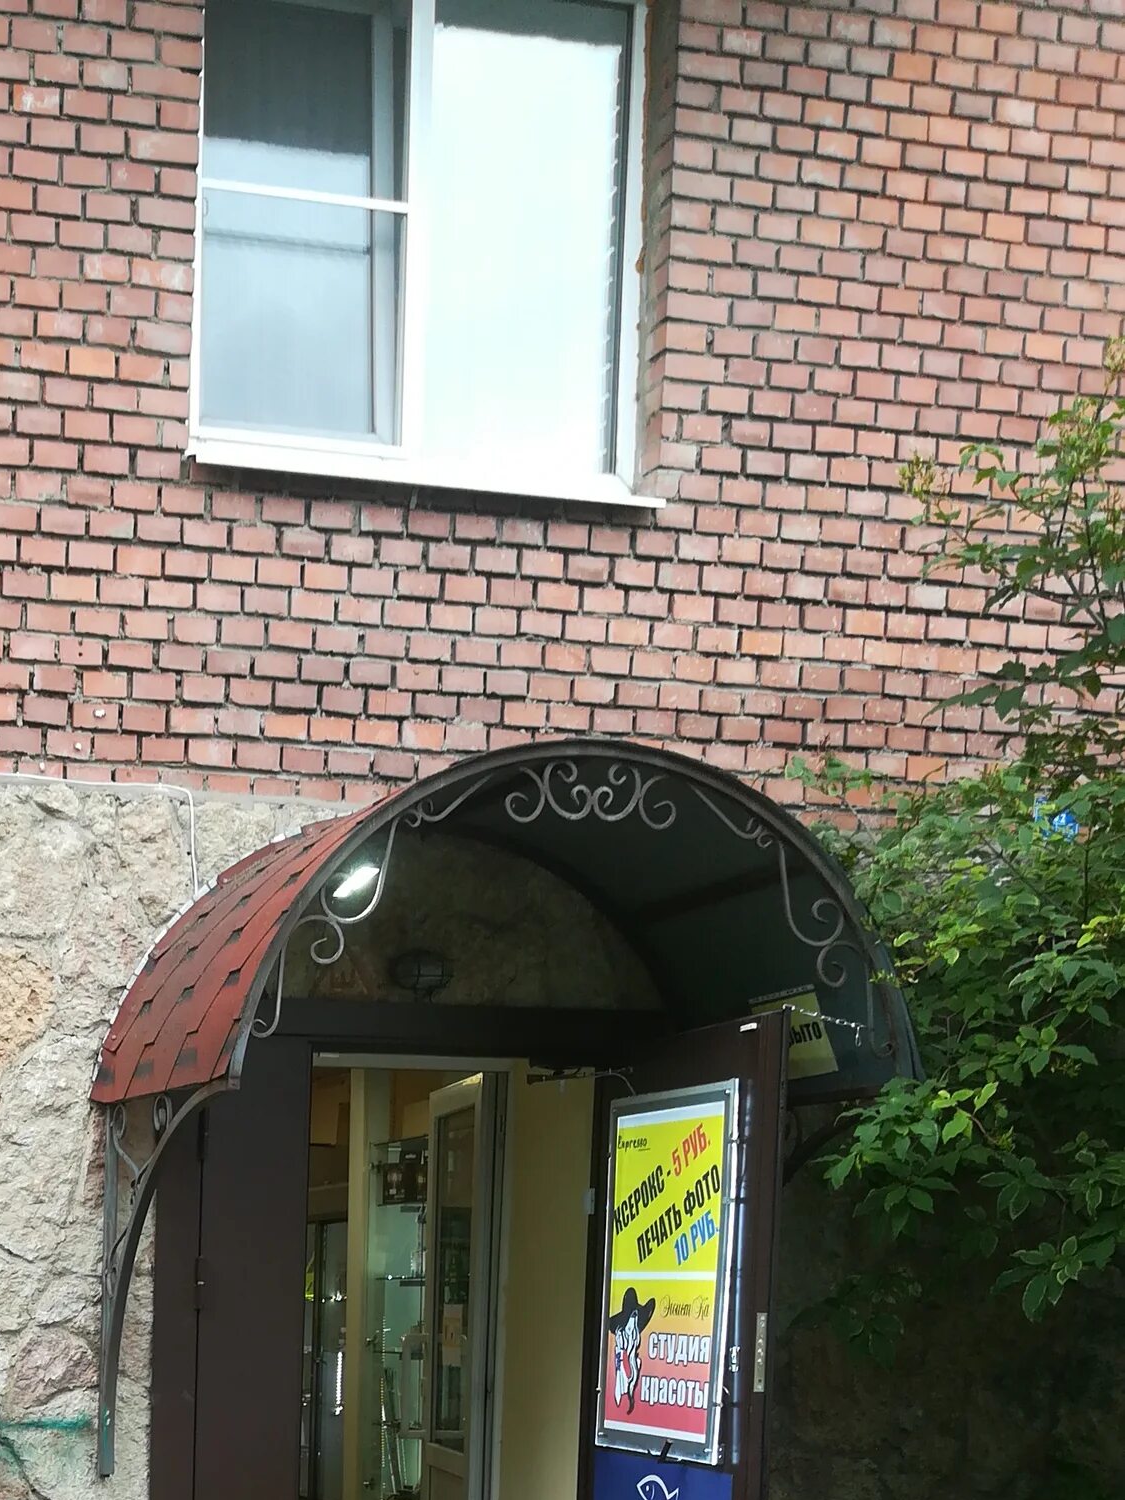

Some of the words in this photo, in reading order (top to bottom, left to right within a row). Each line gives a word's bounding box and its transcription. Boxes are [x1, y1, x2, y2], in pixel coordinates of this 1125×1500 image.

[613, 1164, 665, 1235] КСЕРОКС
[671, 1147, 682, 1177] 5
[682, 1123, 711, 1167] РУБ.
[636, 1203, 682, 1264] ПЕЧАТЬ
[683, 1164, 721, 1217] ФОТО
[674, 1232, 689, 1266] 10
[690, 1209, 719, 1253] РУБ.
[648, 1332, 711, 1367] студия
[640, 1376, 710, 1410] красоты
